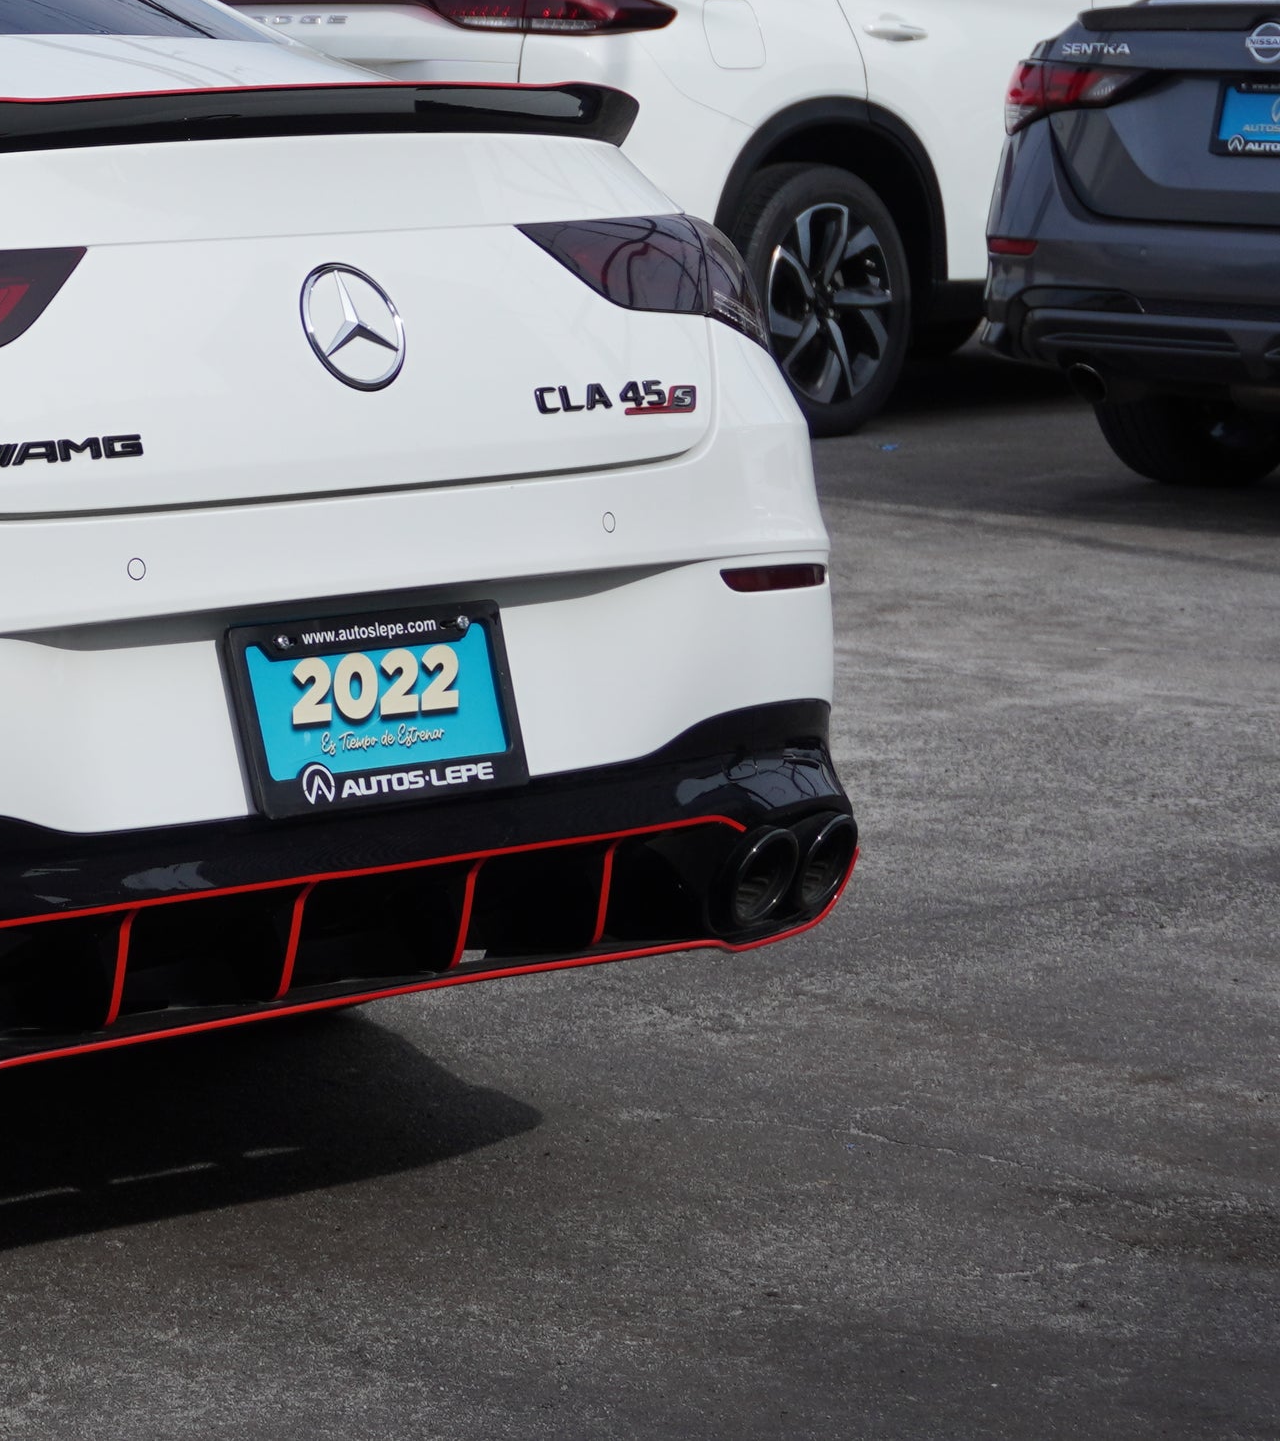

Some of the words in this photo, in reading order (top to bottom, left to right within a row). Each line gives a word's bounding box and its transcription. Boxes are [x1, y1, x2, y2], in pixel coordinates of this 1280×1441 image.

[1062, 43, 1130, 55] SENTRA
[1249, 37, 1280, 46] NISSA
[1242, 123, 1280, 132] AUTOS
[1244, 141, 1280, 152] AUTO
[534, 383, 613, 415] CLA
[301, 618, 437, 645] www.autoslepe.com
[292, 645, 460, 726] 2022
[320, 733, 337, 757] Es
[339, 729, 378, 752] Tiempo
[380, 729, 395, 745] de
[397, 722, 446, 748] Estrenar
